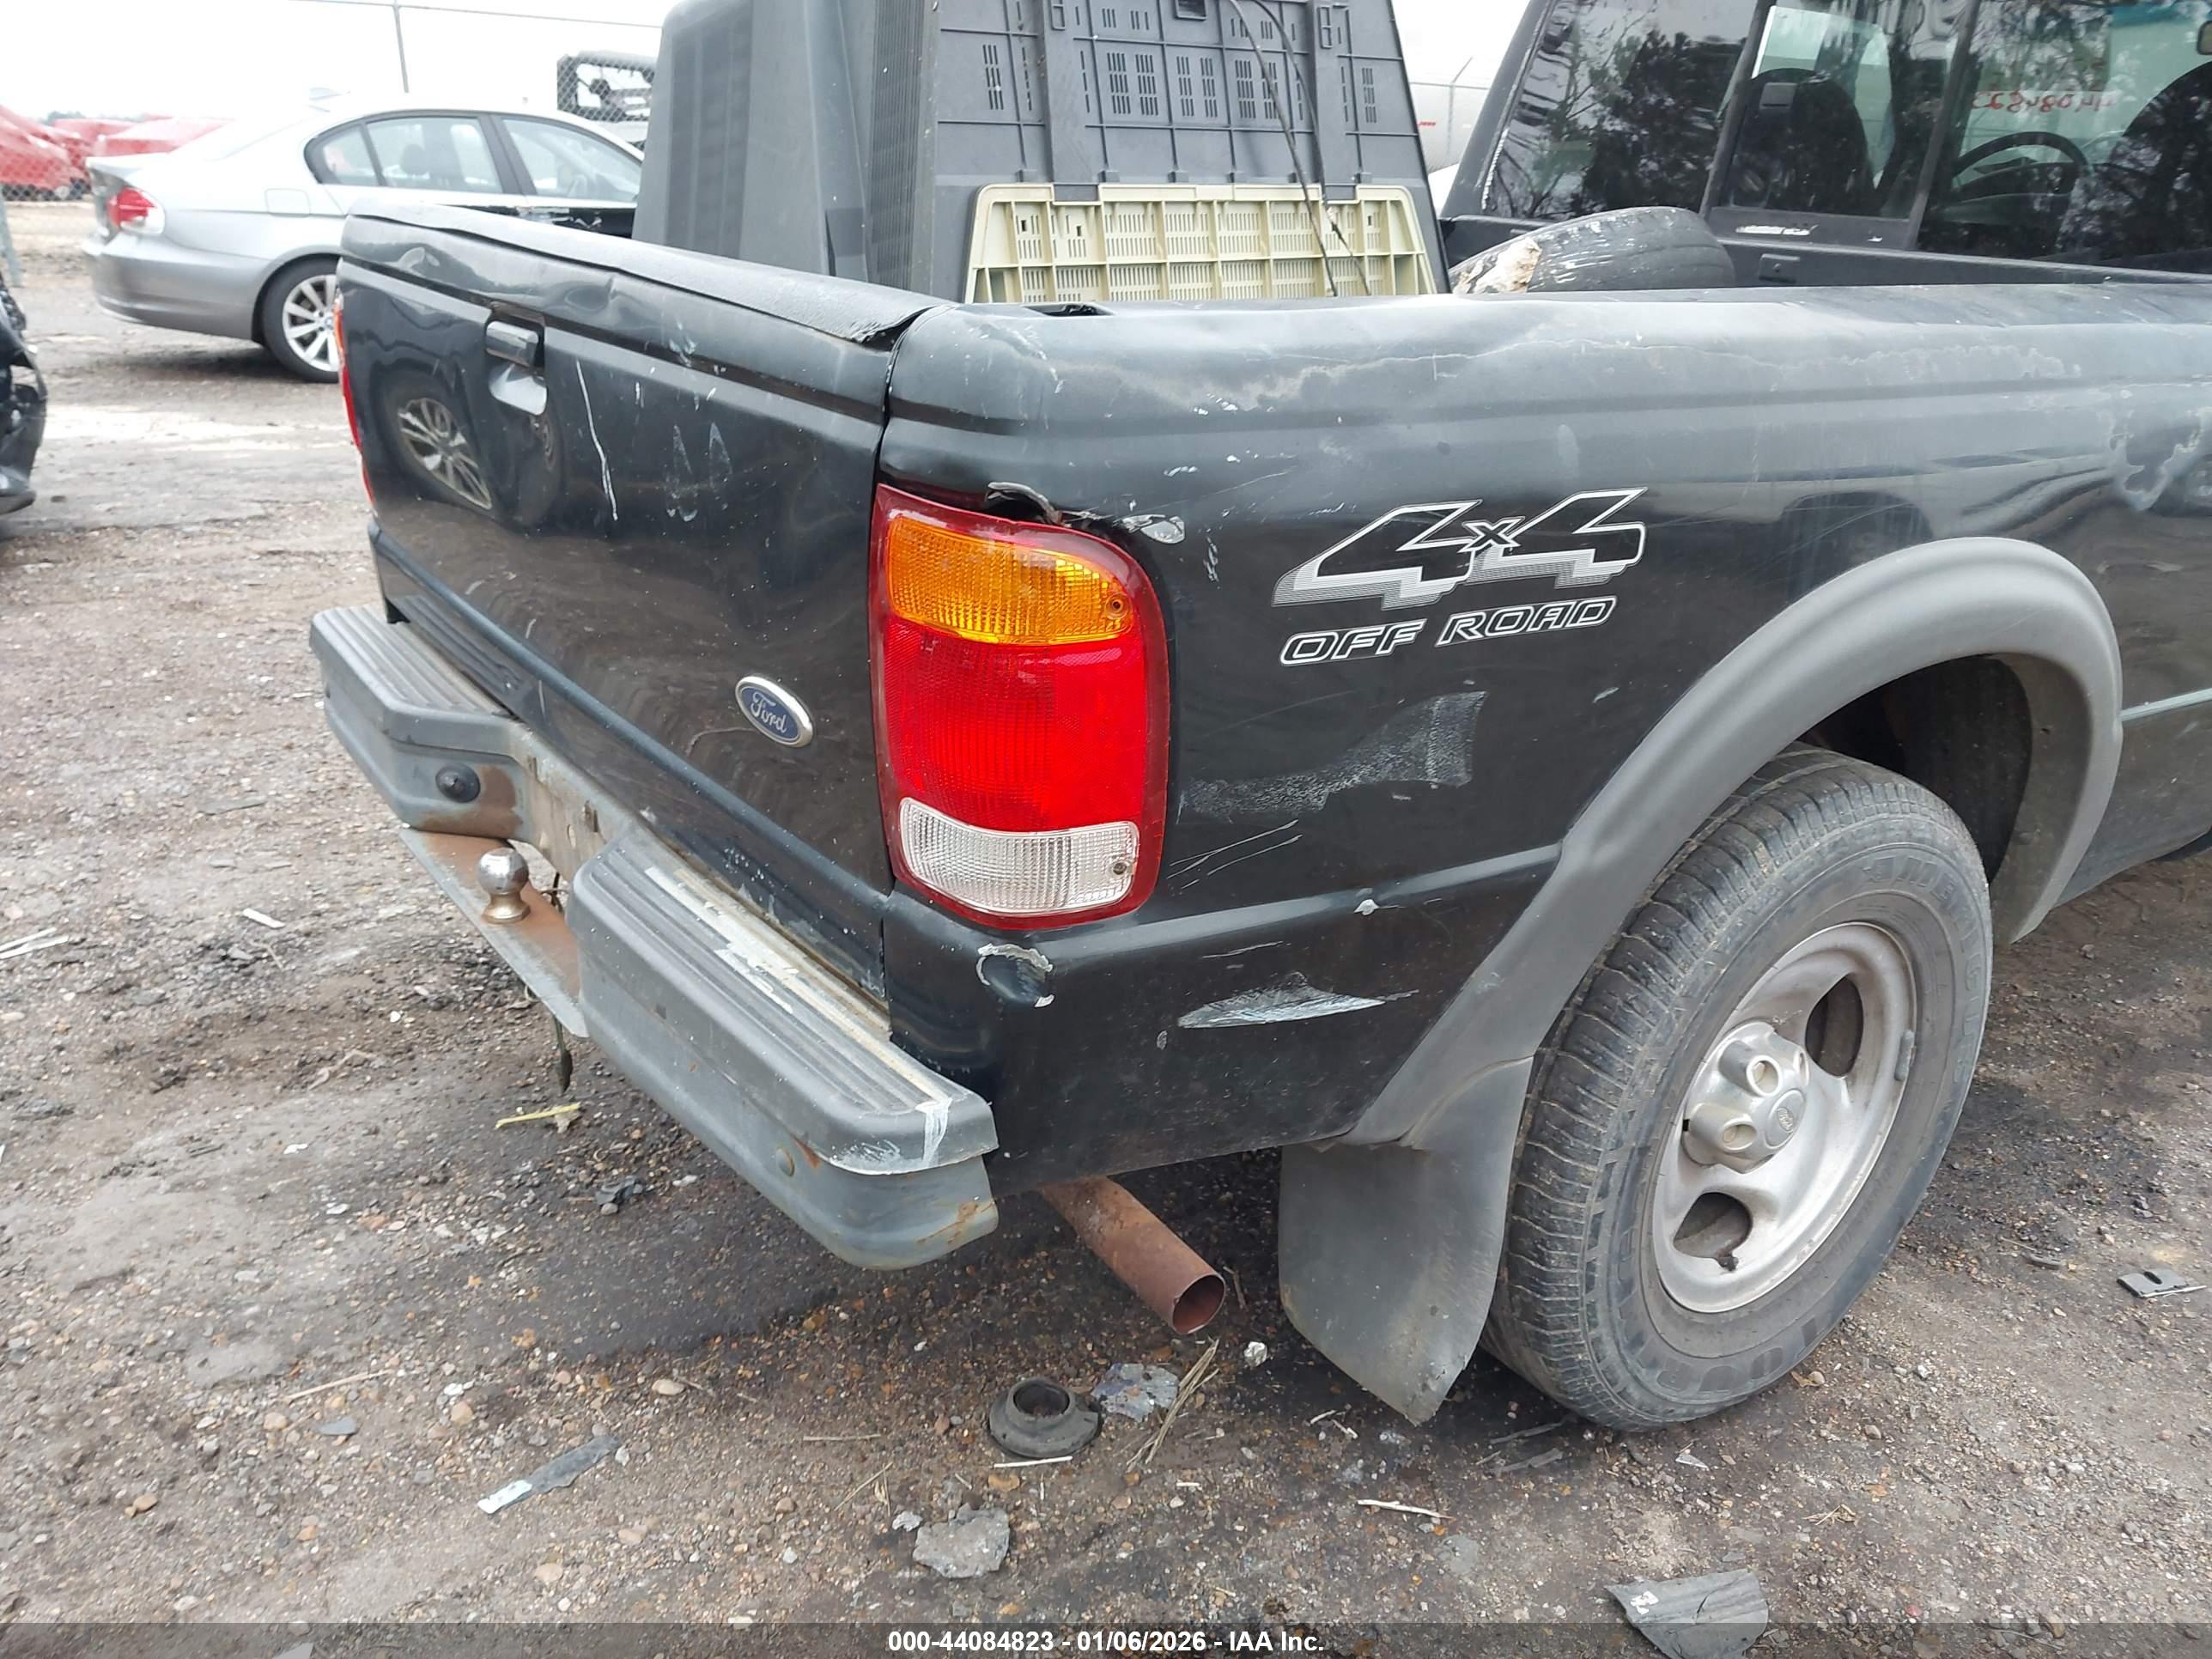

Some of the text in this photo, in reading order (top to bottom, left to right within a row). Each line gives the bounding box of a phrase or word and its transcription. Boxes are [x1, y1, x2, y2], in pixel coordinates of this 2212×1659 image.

[1279, 596, 1618, 666] OFF ROAD
[750, 690, 787, 733] Ford
